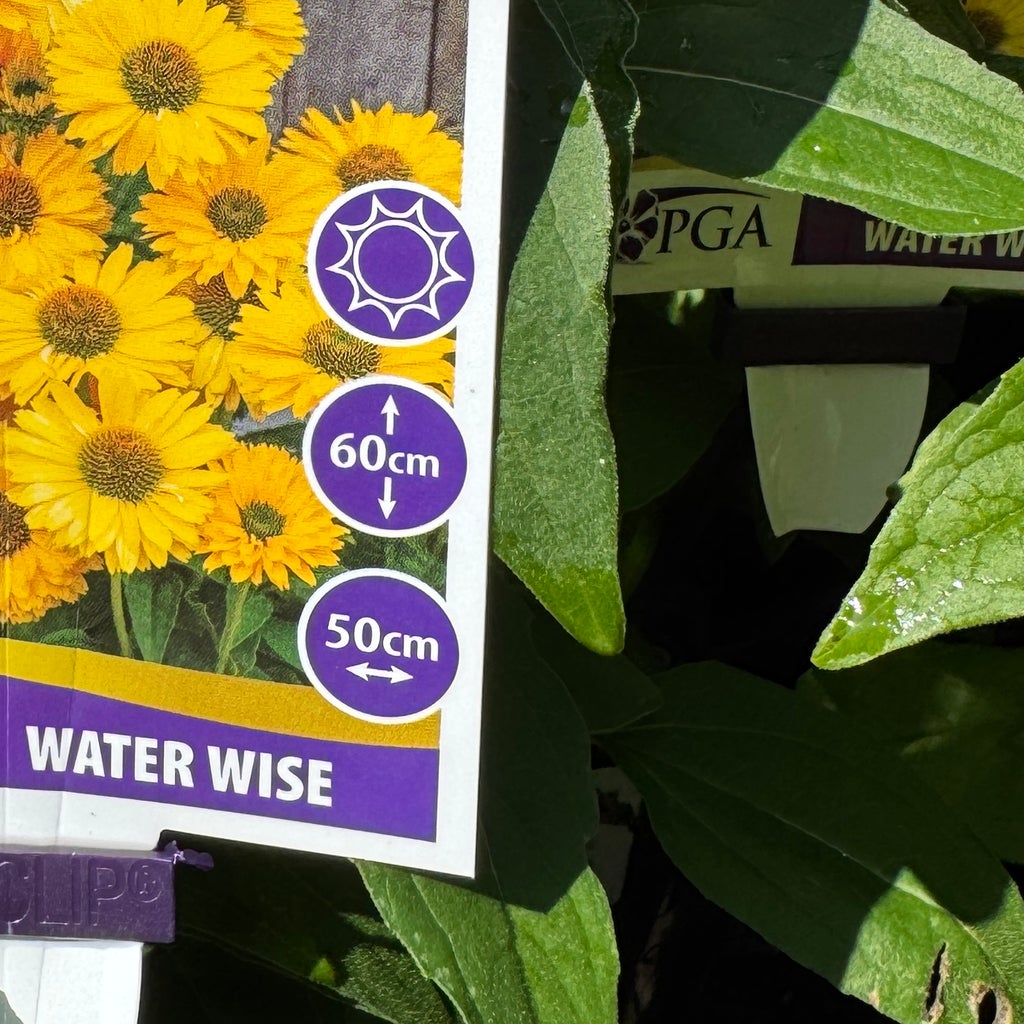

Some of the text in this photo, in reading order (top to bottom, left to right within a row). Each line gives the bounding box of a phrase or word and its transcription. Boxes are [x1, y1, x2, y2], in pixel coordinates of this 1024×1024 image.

[656, 203, 773, 254] PGA
[329, 432, 441, 479] 60cm
[324, 612, 440, 663] 50cm
[25, 724, 335, 808] WATER WISE
